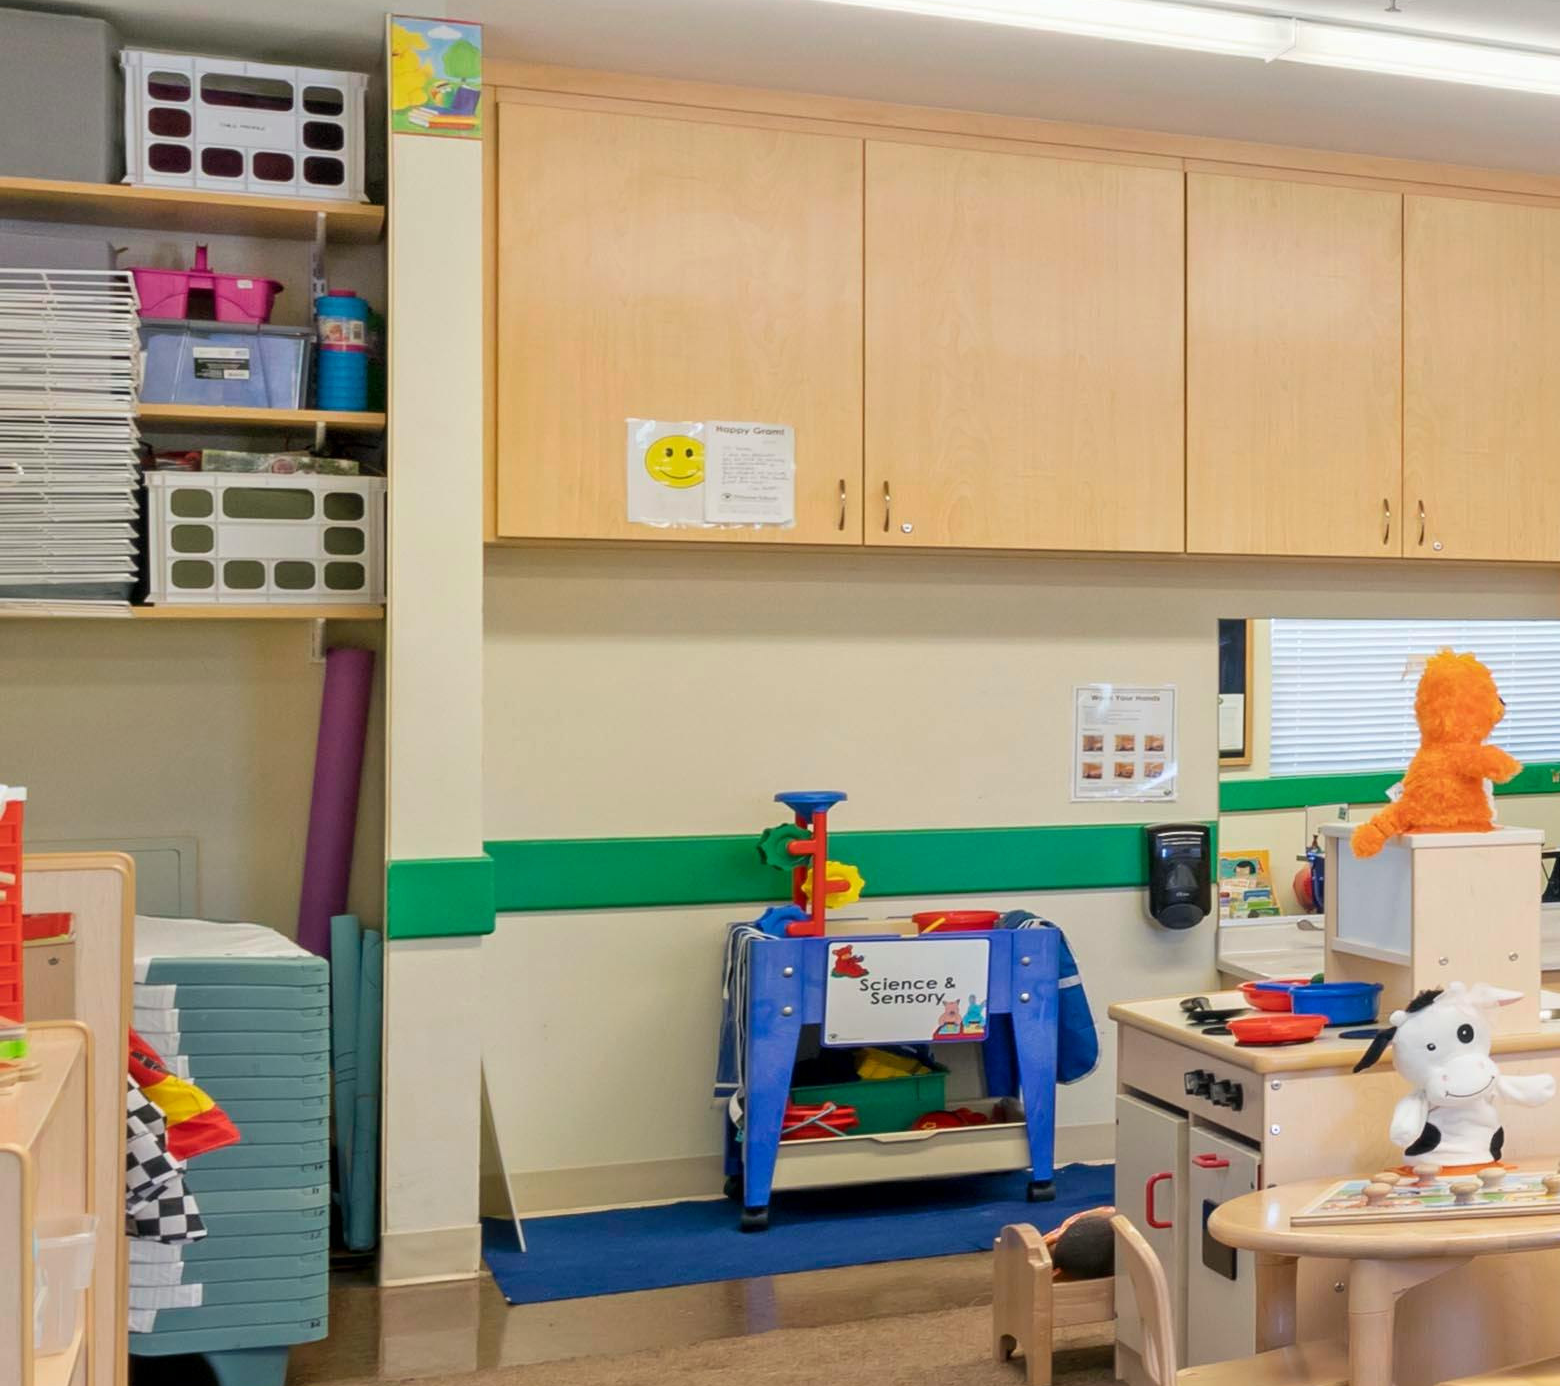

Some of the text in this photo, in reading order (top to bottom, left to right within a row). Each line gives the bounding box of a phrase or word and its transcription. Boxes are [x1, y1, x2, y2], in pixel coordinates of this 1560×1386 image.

[716, 425, 750, 436] Happy
[860, 977, 956, 991] Science &
[870, 992, 945, 1005] Sensory
